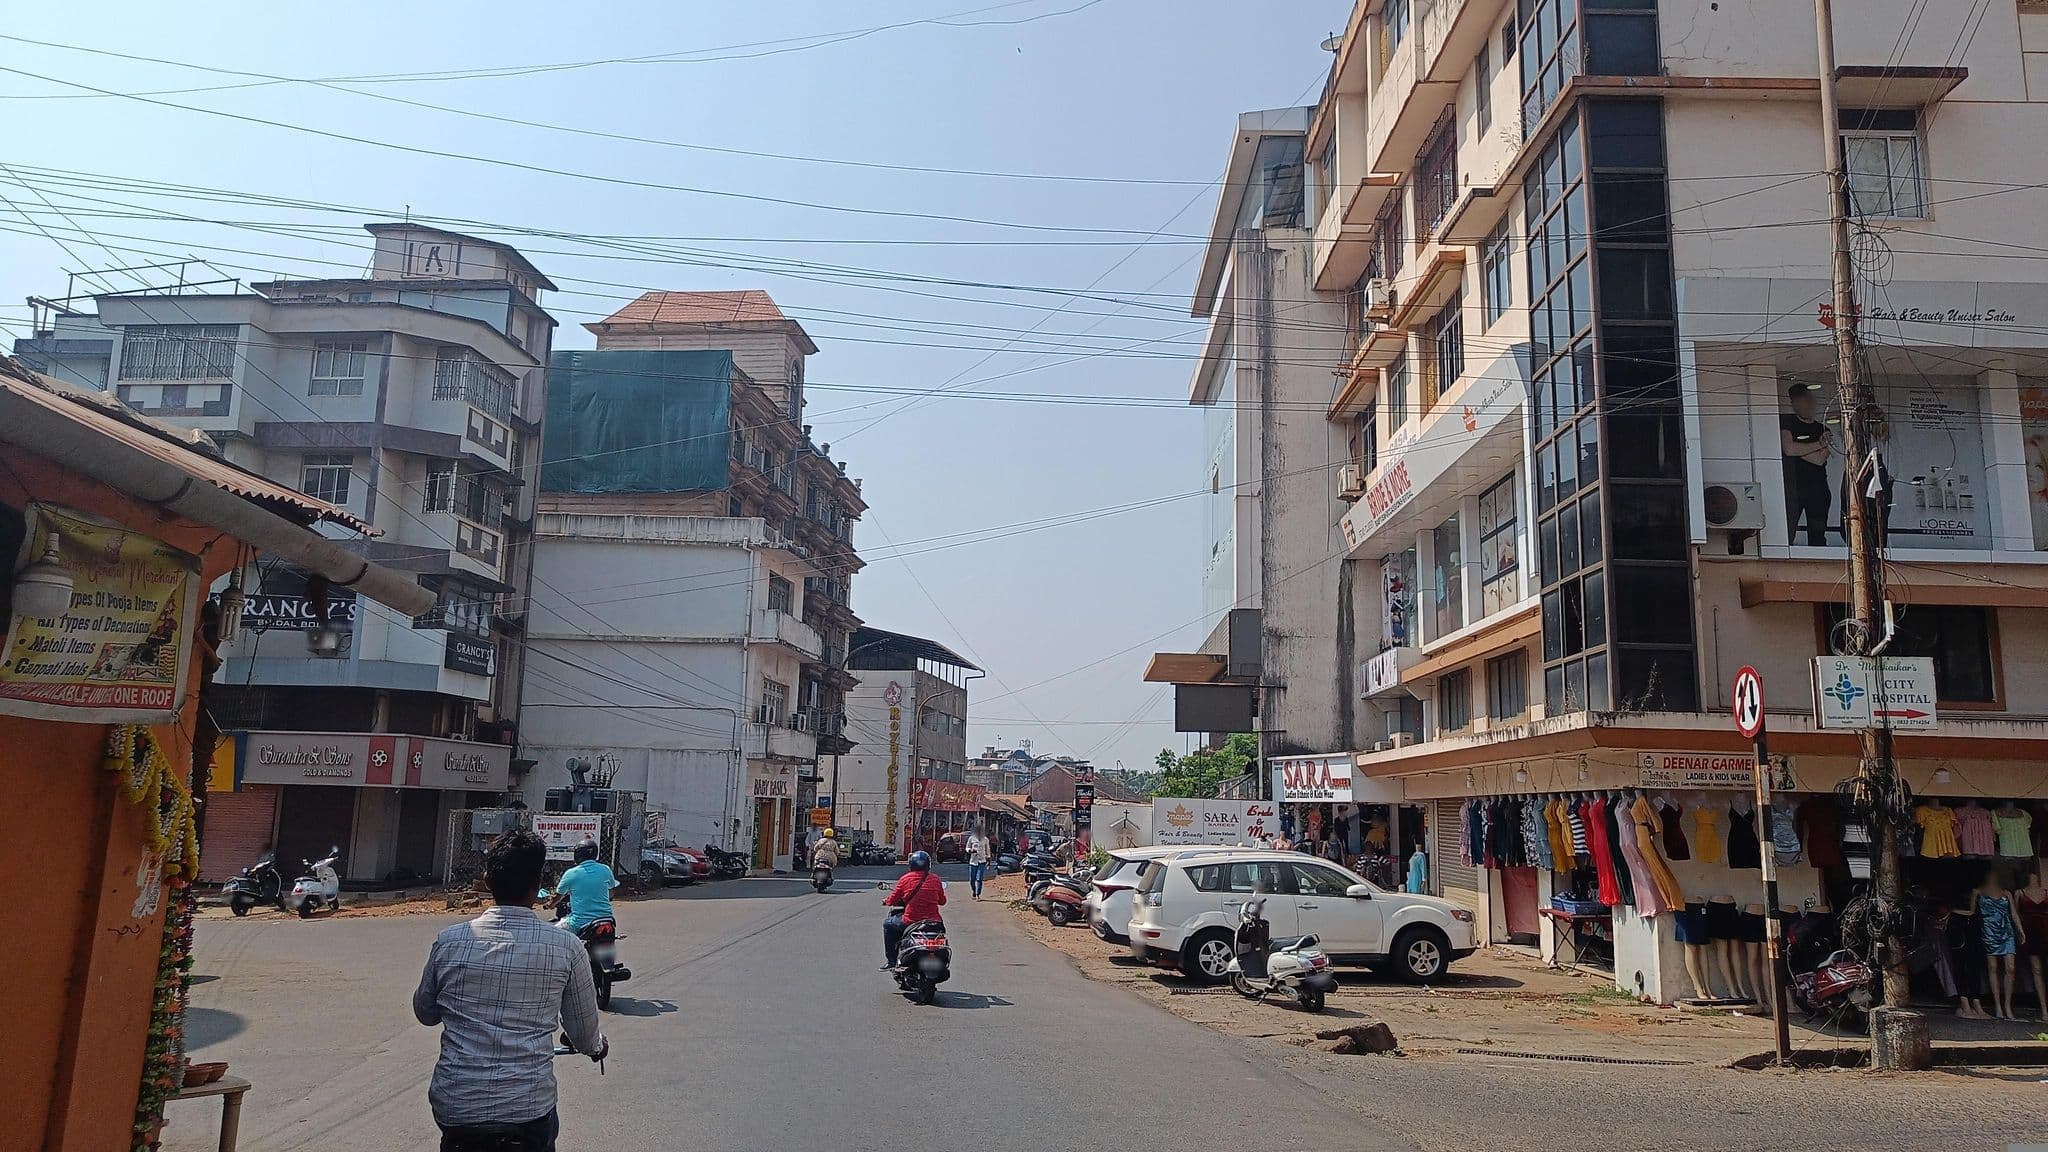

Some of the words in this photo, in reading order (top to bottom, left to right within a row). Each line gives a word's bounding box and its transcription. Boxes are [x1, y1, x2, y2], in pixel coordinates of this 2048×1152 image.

[1870, 306, 1897, 321] Hair
[1899, 308, 1908, 321] &
[1909, 307, 1945, 323] Beauty
[1947, 309, 1983, 322] Unisex
[1984, 308, 2016, 322] Salon
[1366, 483, 1389, 520] BRIDE
[1388, 460, 1412, 499] MORE
[69, 591, 93, 608] ypes
[107, 592, 132, 613] Pooja
[135, 595, 158, 612] Items
[241, 598, 357, 621] RANCY'S
[59, 613, 90, 633] Types
[92, 616, 104, 631] of
[29, 635, 66, 655] Matoli
[69, 637, 96, 654] Items
[14, 657, 61, 678] Ganpati
[62, 662, 89, 676] Idols
[1835, 660, 1850, 671] Dr.
[1884, 680, 1915, 689] CITY
[115, 687, 139, 705] ONE
[141, 689, 171, 706] ROOF
[1872, 694, 1931, 704] HOSPITAL
[1663, 756, 1709, 770] DEENAR
[1711, 757, 1772, 771] GARMES
[1283, 759, 1334, 790] SARA
[1685, 772, 1707, 780] LADIES
[1730, 773, 1750, 781] WEAR
[1204, 812, 1239, 823] SARA
[1246, 804, 1274, 817] Bride
[1182, 830, 1203, 838] Beauty
